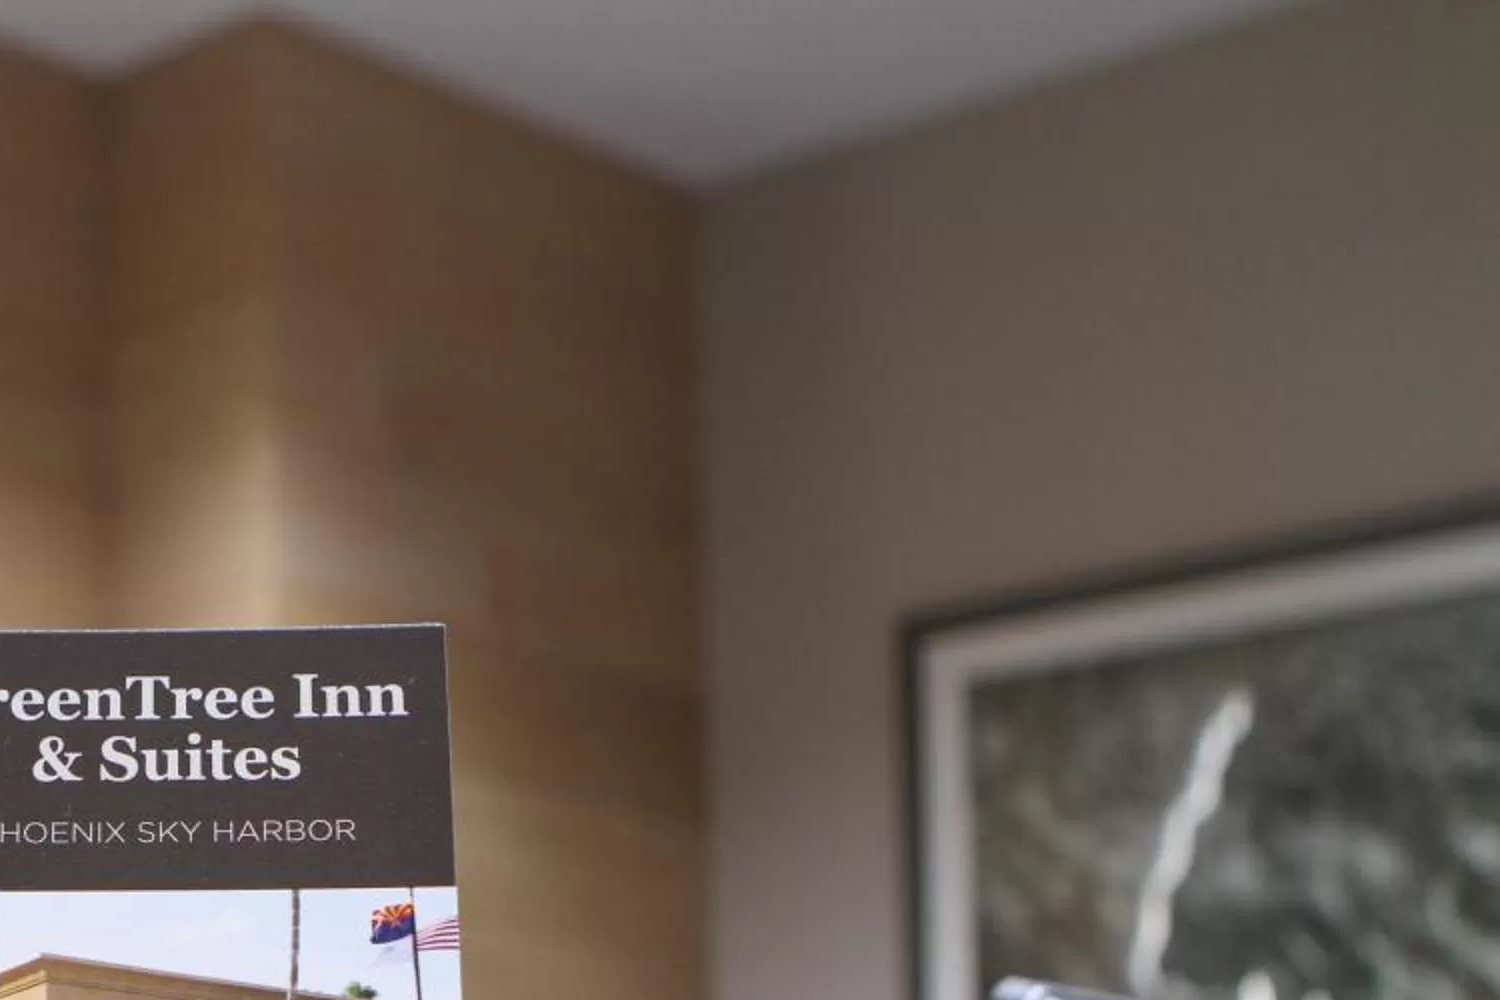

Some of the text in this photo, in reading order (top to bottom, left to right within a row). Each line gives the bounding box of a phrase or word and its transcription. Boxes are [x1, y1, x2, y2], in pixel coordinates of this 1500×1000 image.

[292, 673, 409, 718] Inn
[32, 732, 302, 783] & Suites
[137, 820, 202, 844] SKY
[213, 818, 357, 843] HARBOR
